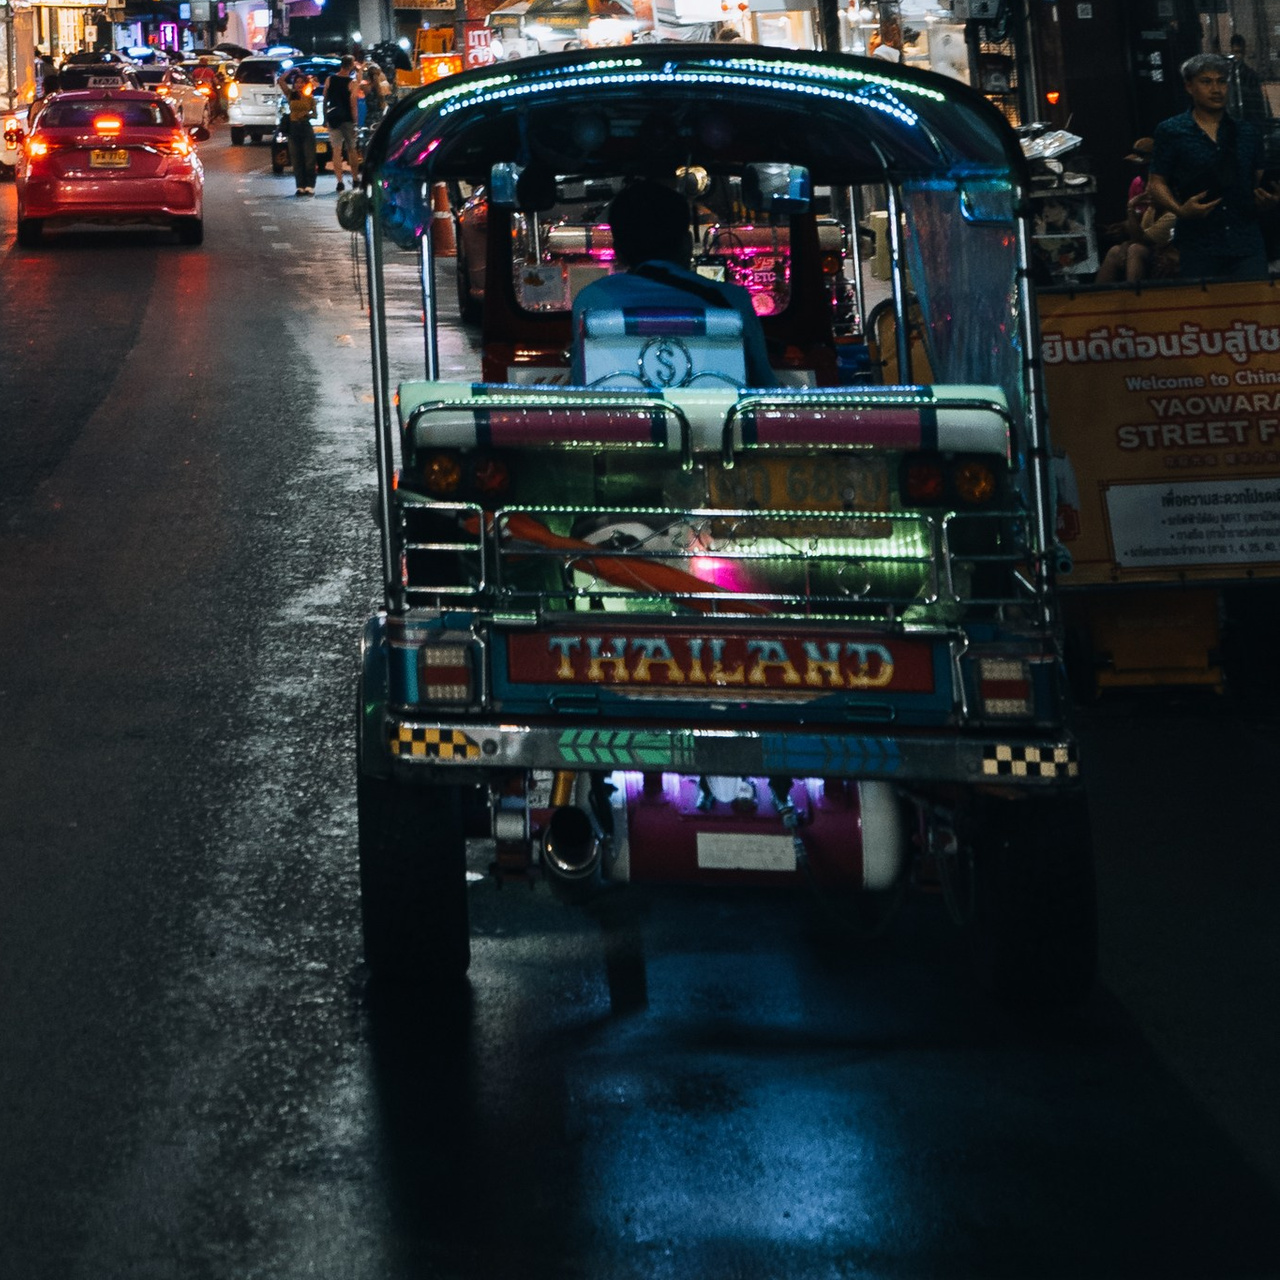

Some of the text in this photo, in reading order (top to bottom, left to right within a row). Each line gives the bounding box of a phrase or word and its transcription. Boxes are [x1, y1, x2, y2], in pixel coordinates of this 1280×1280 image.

[1126, 376, 1205, 391] Welcome
[1209, 373, 1230, 387] to
[1117, 418, 1280, 449] STREET F
